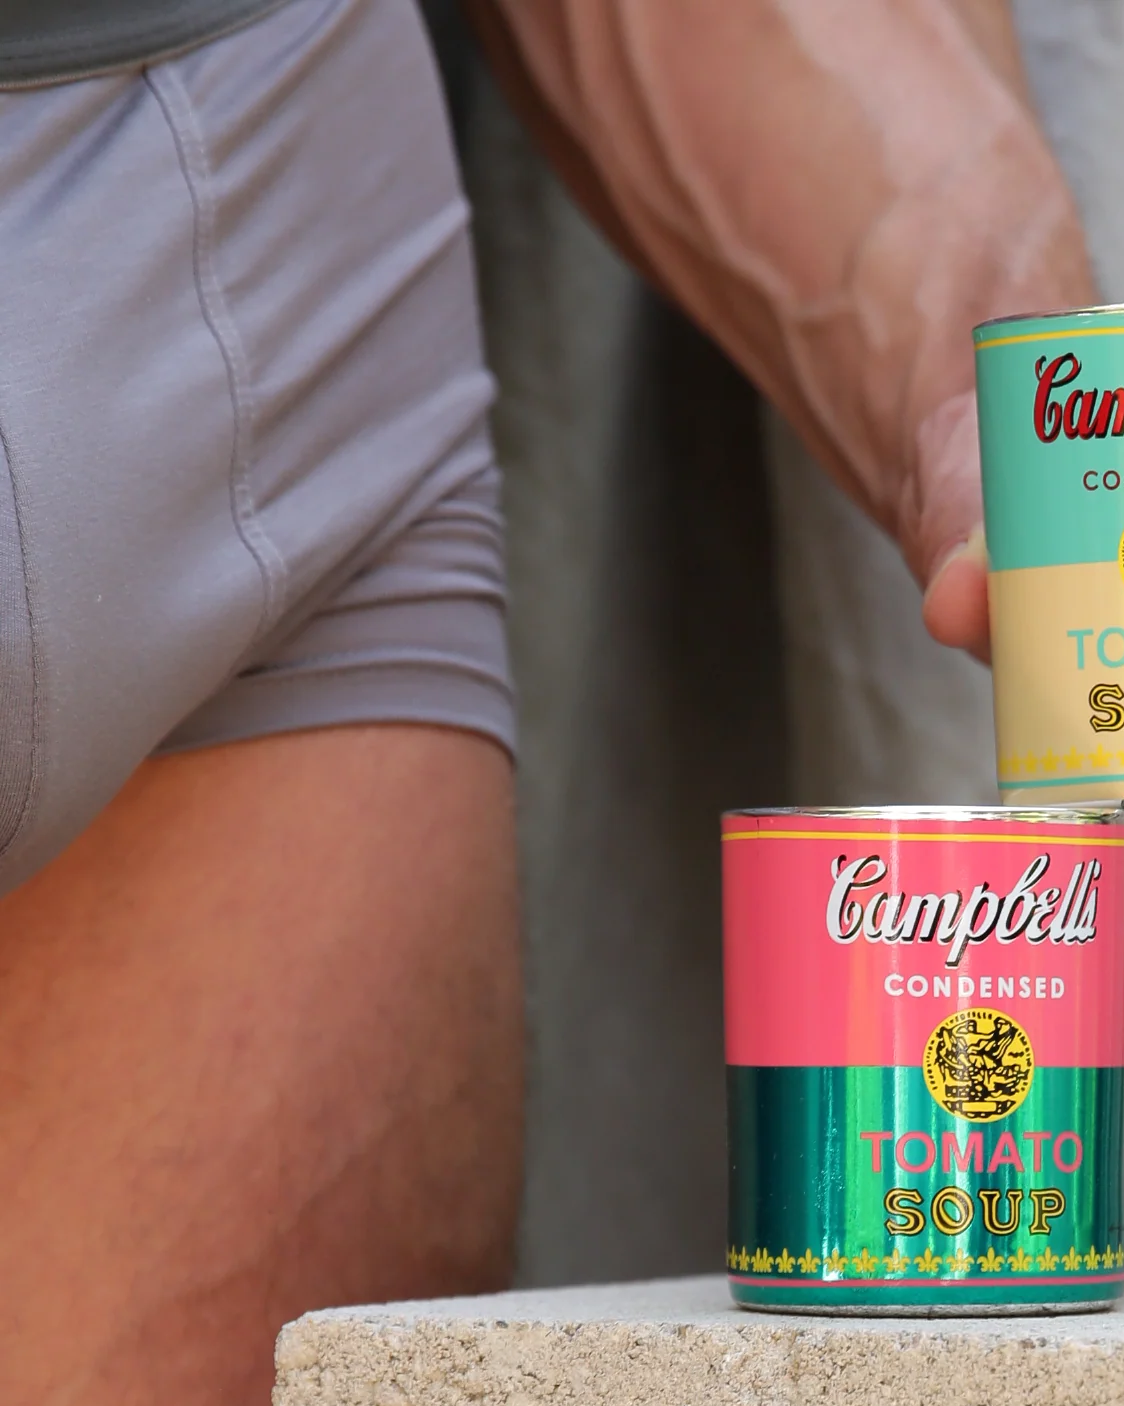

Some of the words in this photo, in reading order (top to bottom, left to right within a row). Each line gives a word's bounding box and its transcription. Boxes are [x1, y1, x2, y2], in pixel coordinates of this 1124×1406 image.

[884, 972, 1065, 999] CONDENSED
[860, 1131, 1084, 1174] TOMATO
[884, 1186, 1066, 1236] SOUP
